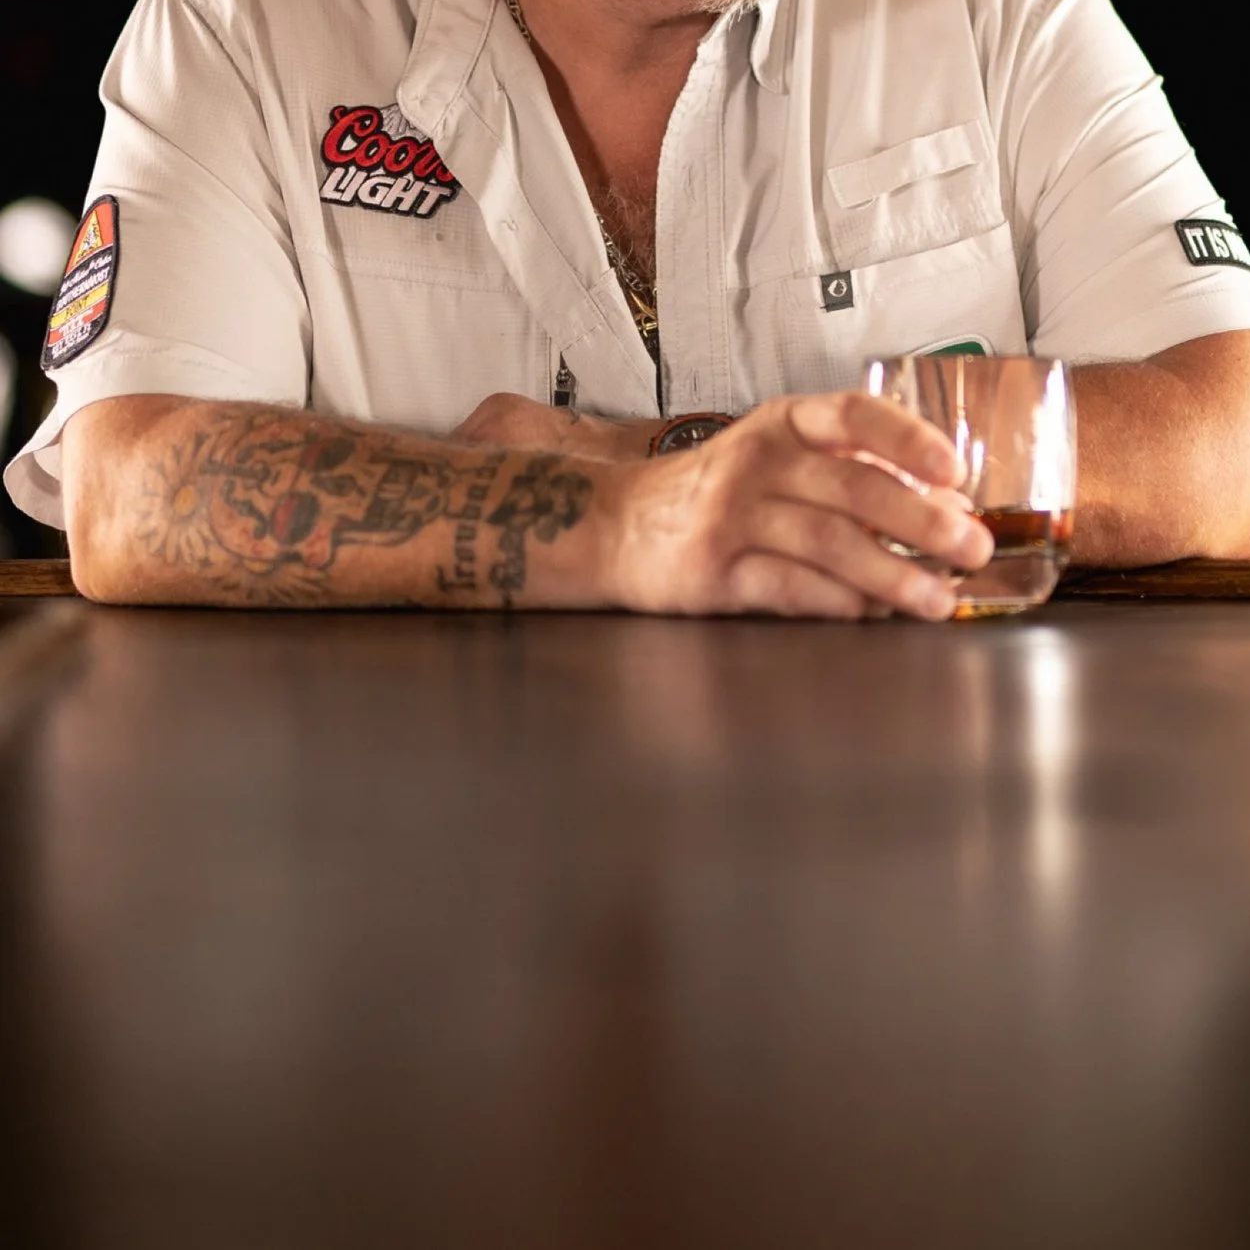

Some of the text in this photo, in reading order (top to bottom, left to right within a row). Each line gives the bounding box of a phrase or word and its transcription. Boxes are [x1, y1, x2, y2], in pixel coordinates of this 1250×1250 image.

[319, 165, 453, 216] LIGHT
[1183, 227, 1209, 258] IT
[1205, 226, 1230, 258] IS
